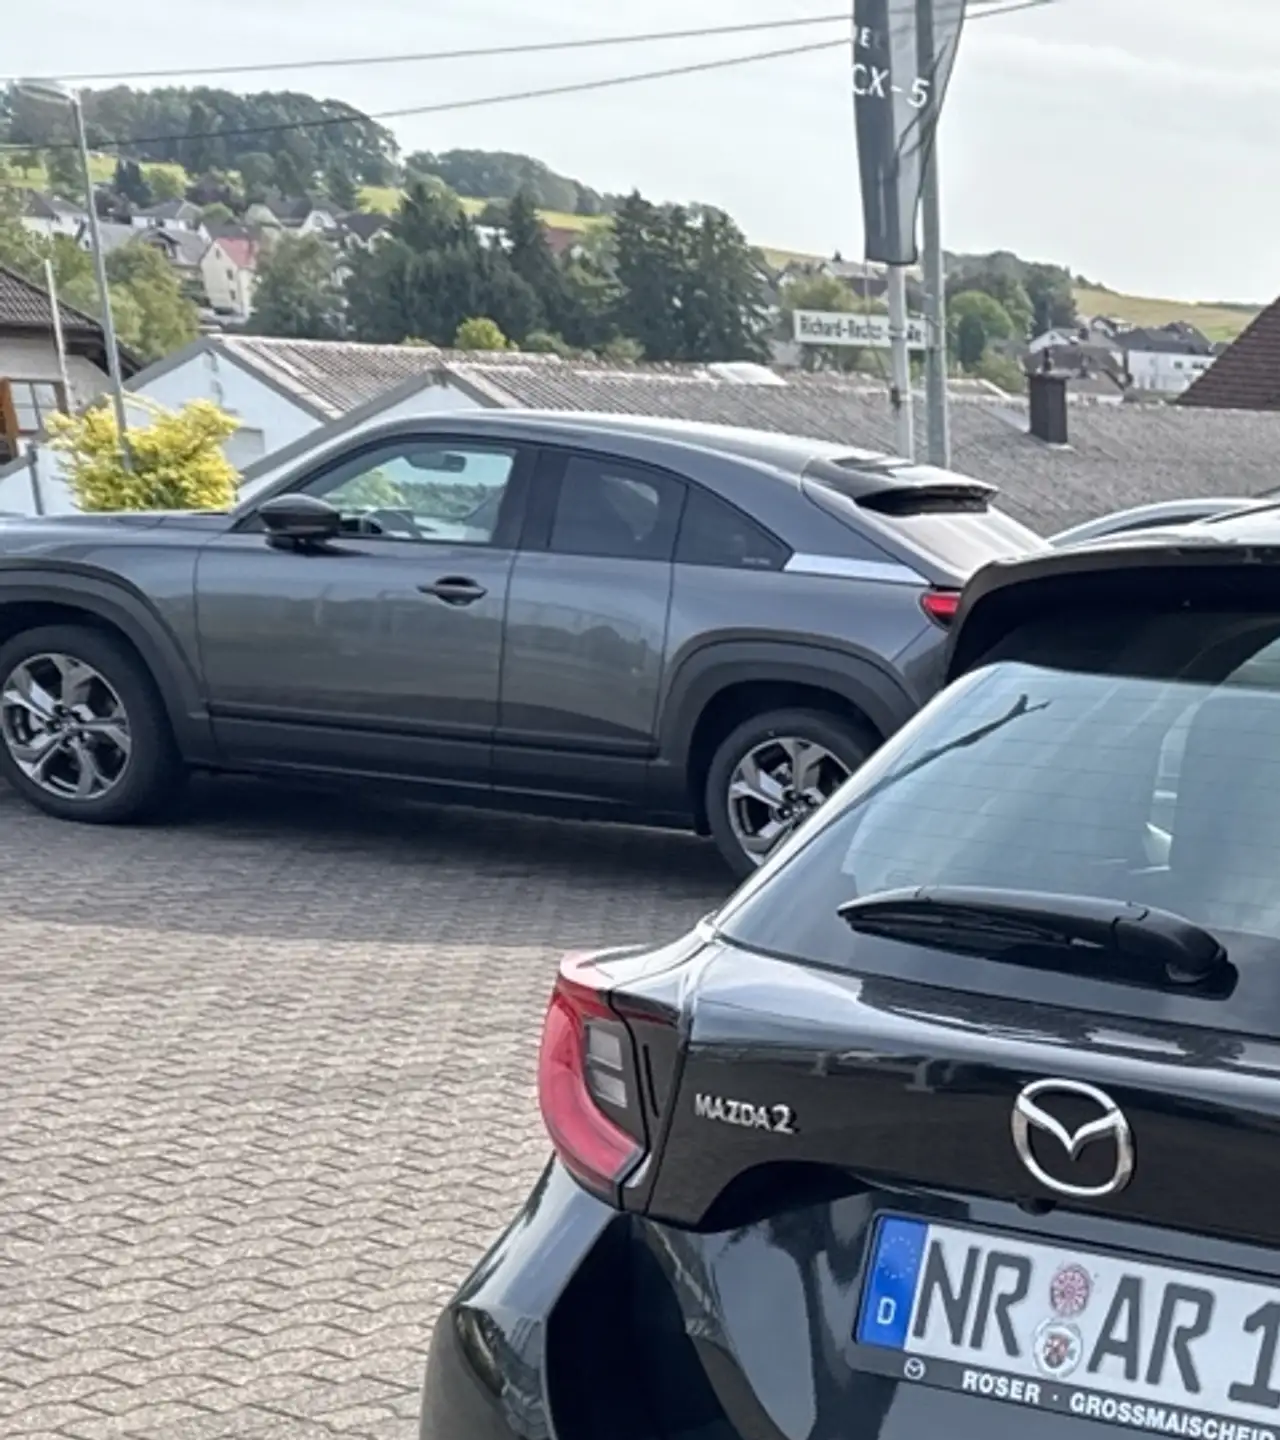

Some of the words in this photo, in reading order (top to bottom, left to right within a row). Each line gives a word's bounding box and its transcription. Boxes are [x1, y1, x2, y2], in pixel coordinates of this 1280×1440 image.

[852, 63, 930, 108] CX-5
[876, 1297, 897, 1325] D
[911, 1239, 1032, 1357] NR
[1085, 1273, 1216, 1394] AR
